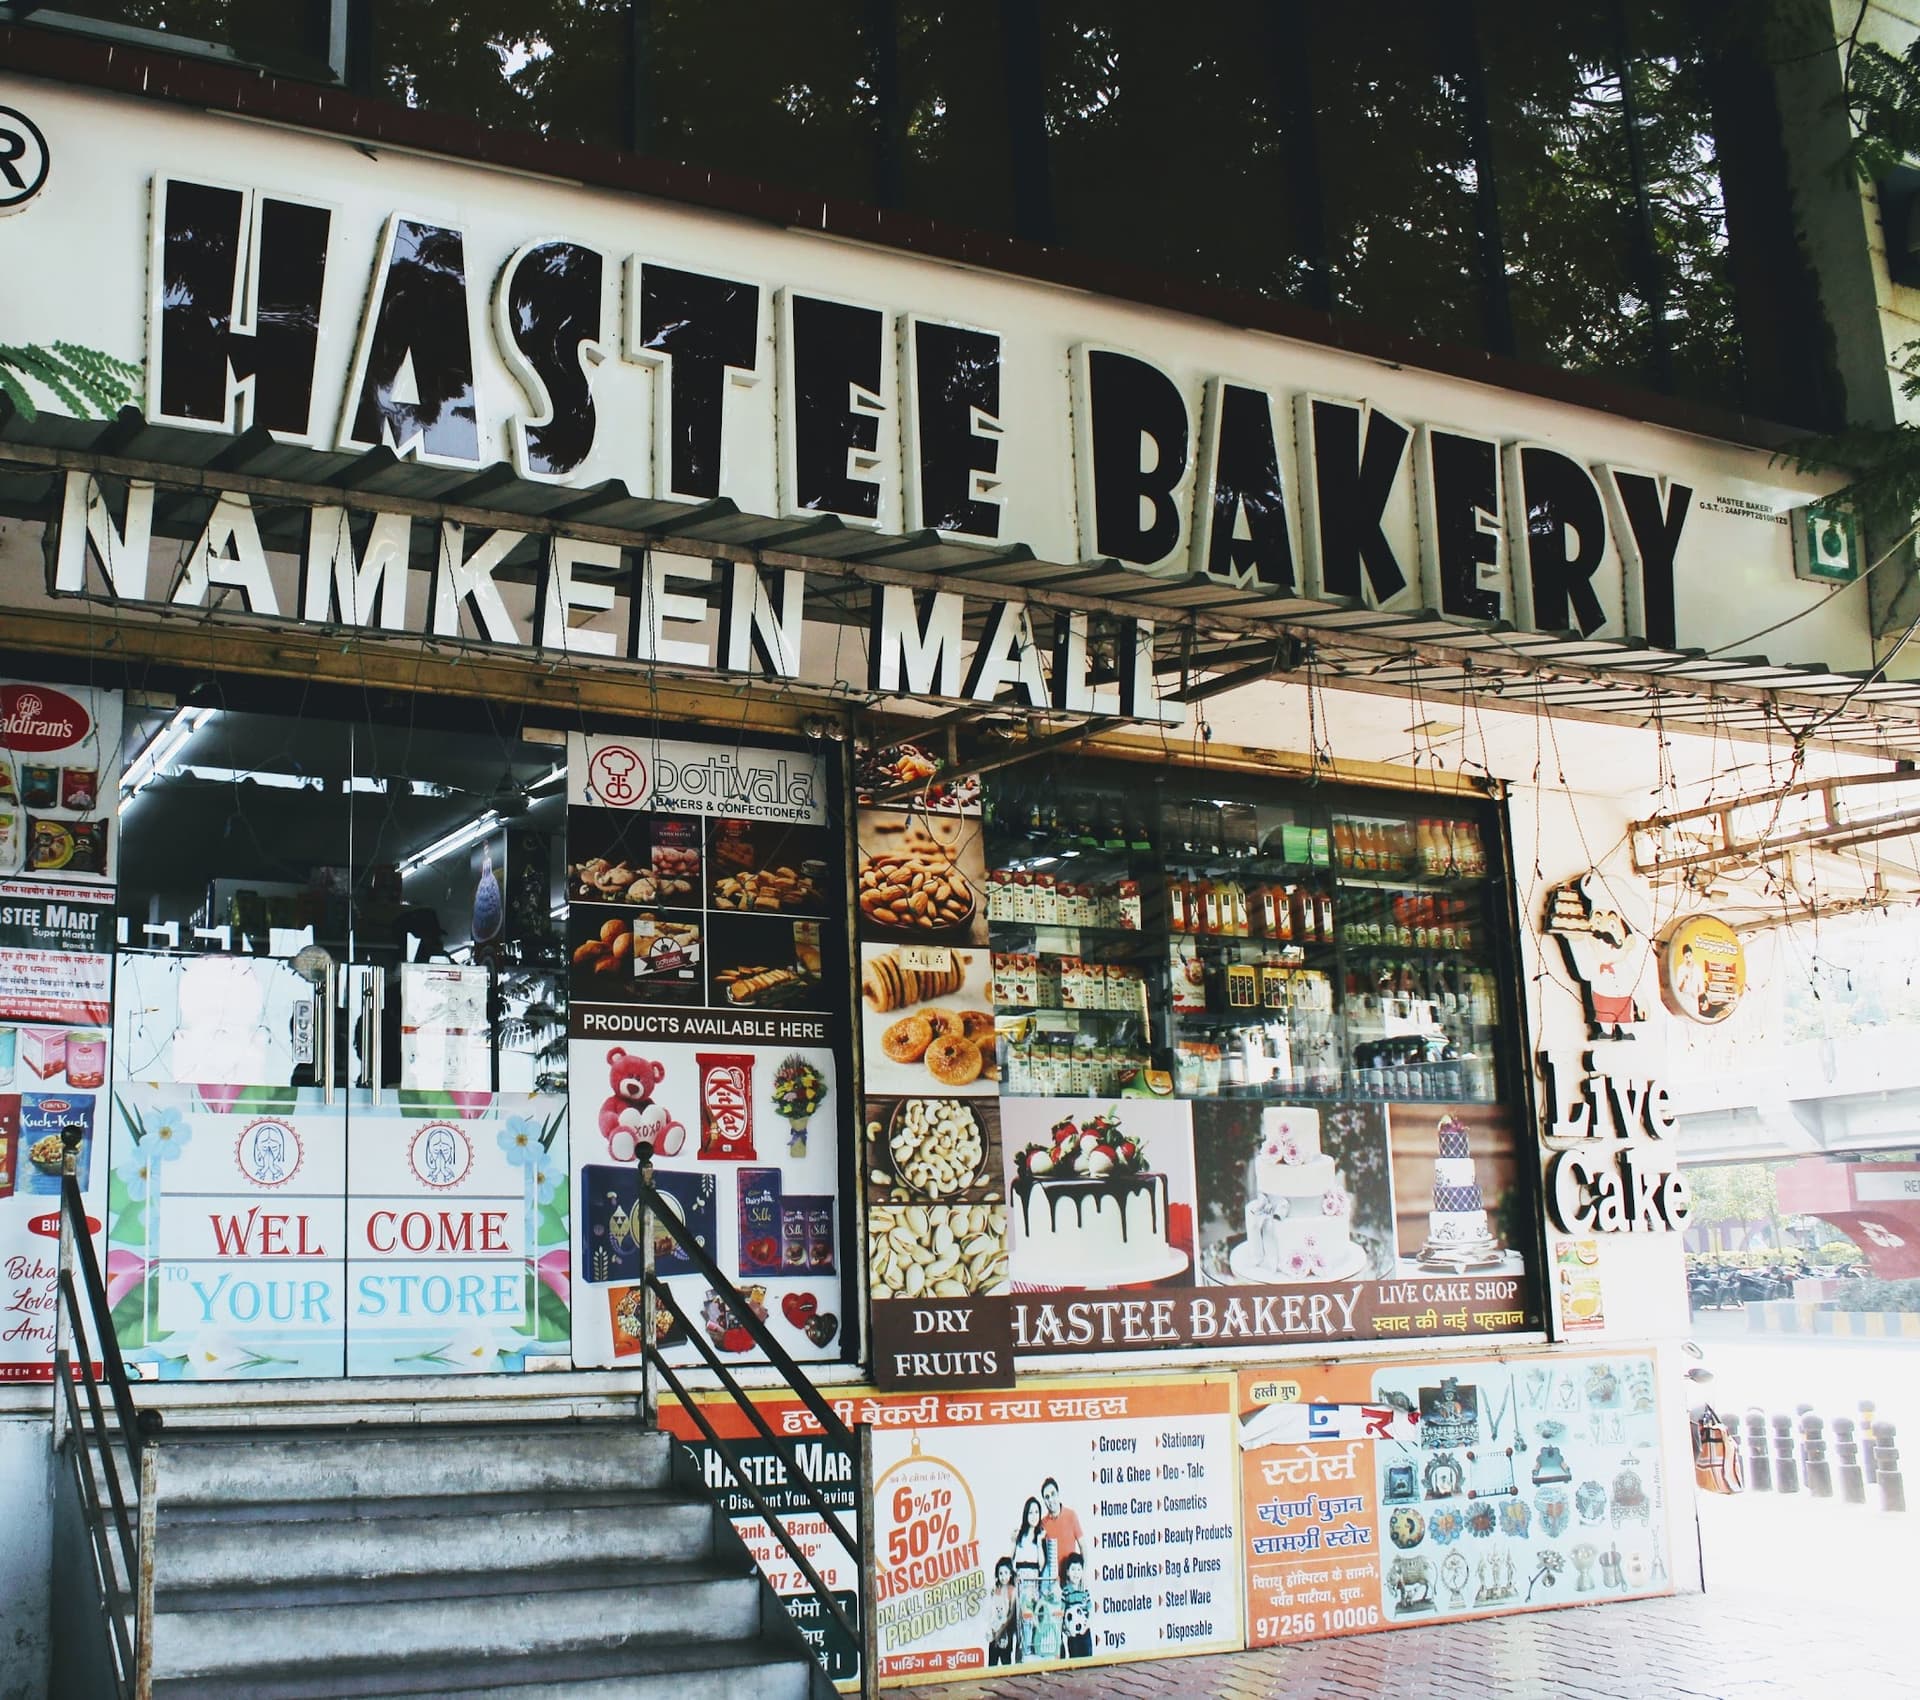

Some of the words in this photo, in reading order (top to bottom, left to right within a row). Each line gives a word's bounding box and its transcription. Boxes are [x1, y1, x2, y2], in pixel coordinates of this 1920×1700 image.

[148, 168, 1004, 540] HASTEE
[1072, 342, 1694, 650] BAKERY
[1716, 496, 1744, 508] HASTEE
[1745, 501, 1773, 513] BAKERY
[50, 472, 805, 678] NAMKEEN
[872, 584, 1186, 724] MALL
[0, 713, 73, 738] aldiram's
[656, 794, 703, 811] BAKERS
[706, 802, 715, 812] &
[717, 801, 811, 820] CONFECTIONERS
[0, 907, 40, 927] STEE
[46, 904, 99, 931] MART
[32, 928, 60, 938] Super
[62, 929, 96, 940] Market
[583, 1013, 679, 1034] PRODUCTS
[683, 1016, 775, 1037] AVAILABLE
[780, 1021, 824, 1039] HERE
[1541, 1050, 1680, 1141] Live
[1548, 1149, 1693, 1236] Cake
[1904, 1179, 1920, 1193] RE
[210, 1205, 328, 1257] WEL
[366, 1211, 511, 1254] COME
[164, 1266, 189, 1282] TO
[192, 1272, 333, 1325] YOUR
[358, 1274, 522, 1318] STORE
[1379, 1282, 1419, 1304] LIVE
[1422, 1282, 1472, 1303] CAKE
[1475, 1281, 1518, 1300] SHOP
[913, 1310, 973, 1334] DRY
[1011, 1299, 1180, 1348] HASTEE
[1189, 1283, 1364, 1339] BAKERY
[1372, 1316, 1411, 1332] स्वाद
[1415, 1308, 1438, 1329] की
[1443, 1307, 1468, 1331] नई
[1472, 1311, 1524, 1331] पहचान
[895, 1350, 997, 1378] FRUITS
[946, 1397, 982, 1422] का
[990, 1397, 1043, 1419] नया
[1048, 1396, 1129, 1419] साहस
[1099, 1436, 1137, 1454] Grocery
[1161, 1432, 1205, 1450] Stationary
[795, 1442, 853, 1483] MAR
[1162, 1464, 1179, 1480] Deo
[1187, 1463, 1205, 1479] Talc
[1100, 1466, 1113, 1485] Oil
[1116, 1467, 1124, 1483] &
[1126, 1466, 1151, 1483] Ghee
[729, 1493, 781, 1510] Discnt
[893, 1486, 931, 1524] 6%
[1100, 1500, 1128, 1517] Home
[1131, 1498, 1153, 1514] Care
[1163, 1494, 1208, 1512] Cosmetics
[888, 1508, 960, 1567] 50%
[1101, 1532, 1130, 1549] FMCG
[1132, 1529, 1156, 1547] Food
[1164, 1526, 1194, 1546] Beauty
[1195, 1523, 1233, 1541] Products
[875, 1540, 980, 1603] DISCOUNT
[1102, 1563, 1124, 1582] Cold
[1126, 1562, 1158, 1579] Drinks
[1165, 1559, 1181, 1578] Bag
[1183, 1558, 1190, 1573] &
[1192, 1556, 1221, 1572] Purses
[877, 1604, 895, 1628] ON
[898, 1593, 923, 1620] ALL
[923, 1570, 985, 1609] BRANDED
[1103, 1593, 1152, 1614] Chocolate
[1165, 1590, 1188, 1608] Steel
[1190, 1588, 1212, 1606] Ware
[1166, 1620, 1213, 1643] Disposable
[1256, 1612, 1316, 1639] 97256
[1322, 1605, 1379, 1632] 10006
[1104, 1629, 1126, 1649] Toys
